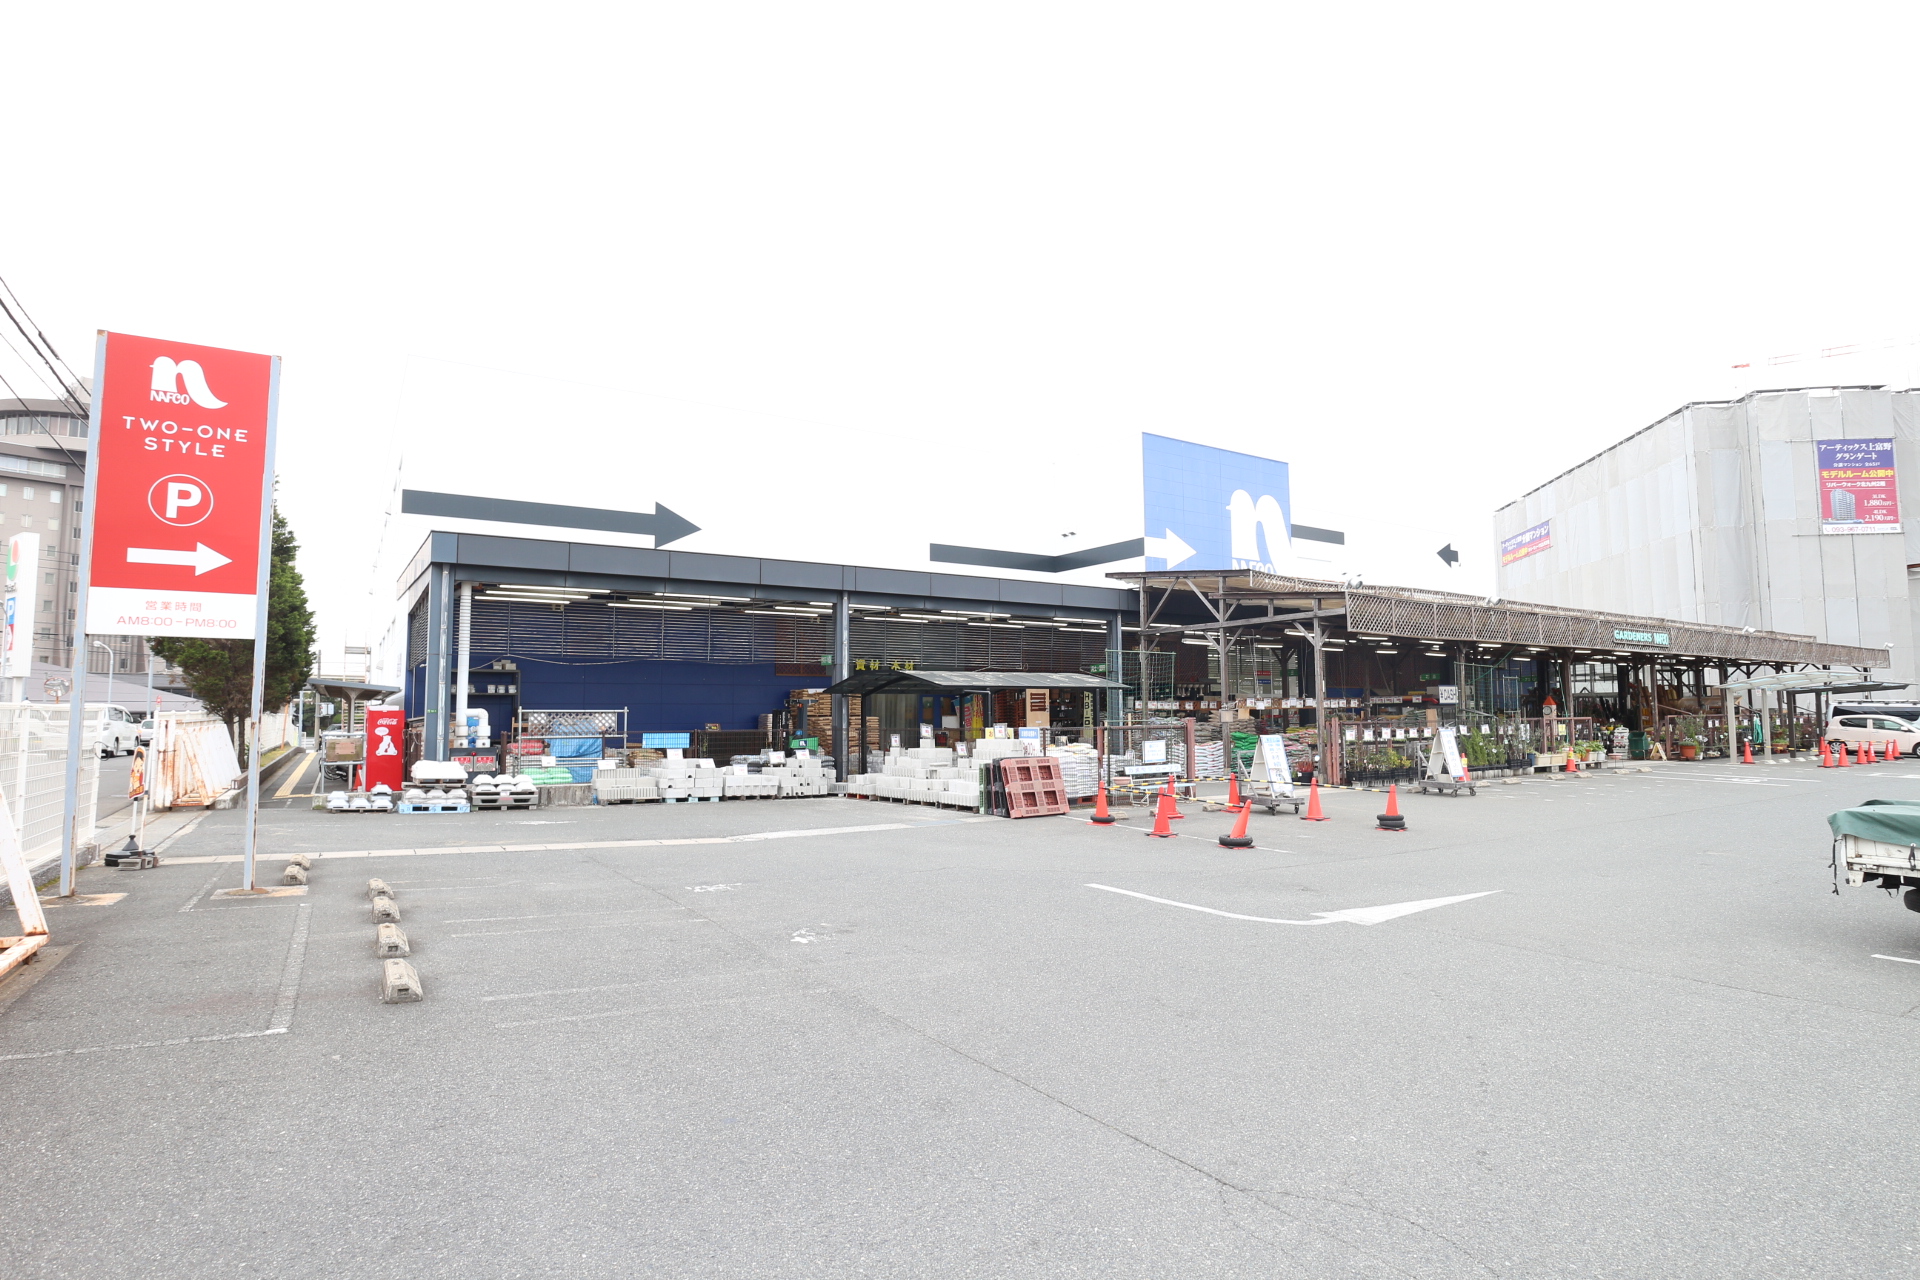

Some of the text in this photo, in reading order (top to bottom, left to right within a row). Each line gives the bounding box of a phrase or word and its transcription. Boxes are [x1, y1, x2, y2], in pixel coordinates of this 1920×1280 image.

[150, 389, 190, 405] NAFCO
[122, 415, 248, 442] TWO-ONE
[144, 437, 226, 457] STYLE
[1821, 470, 1894, 478] モデルルーム公開中
[165, 481, 202, 518] P
[145, 600, 202, 612] 営業時間
[1614, 630, 1652, 642] GARDENERS
[890, 659, 914, 671] 木材
